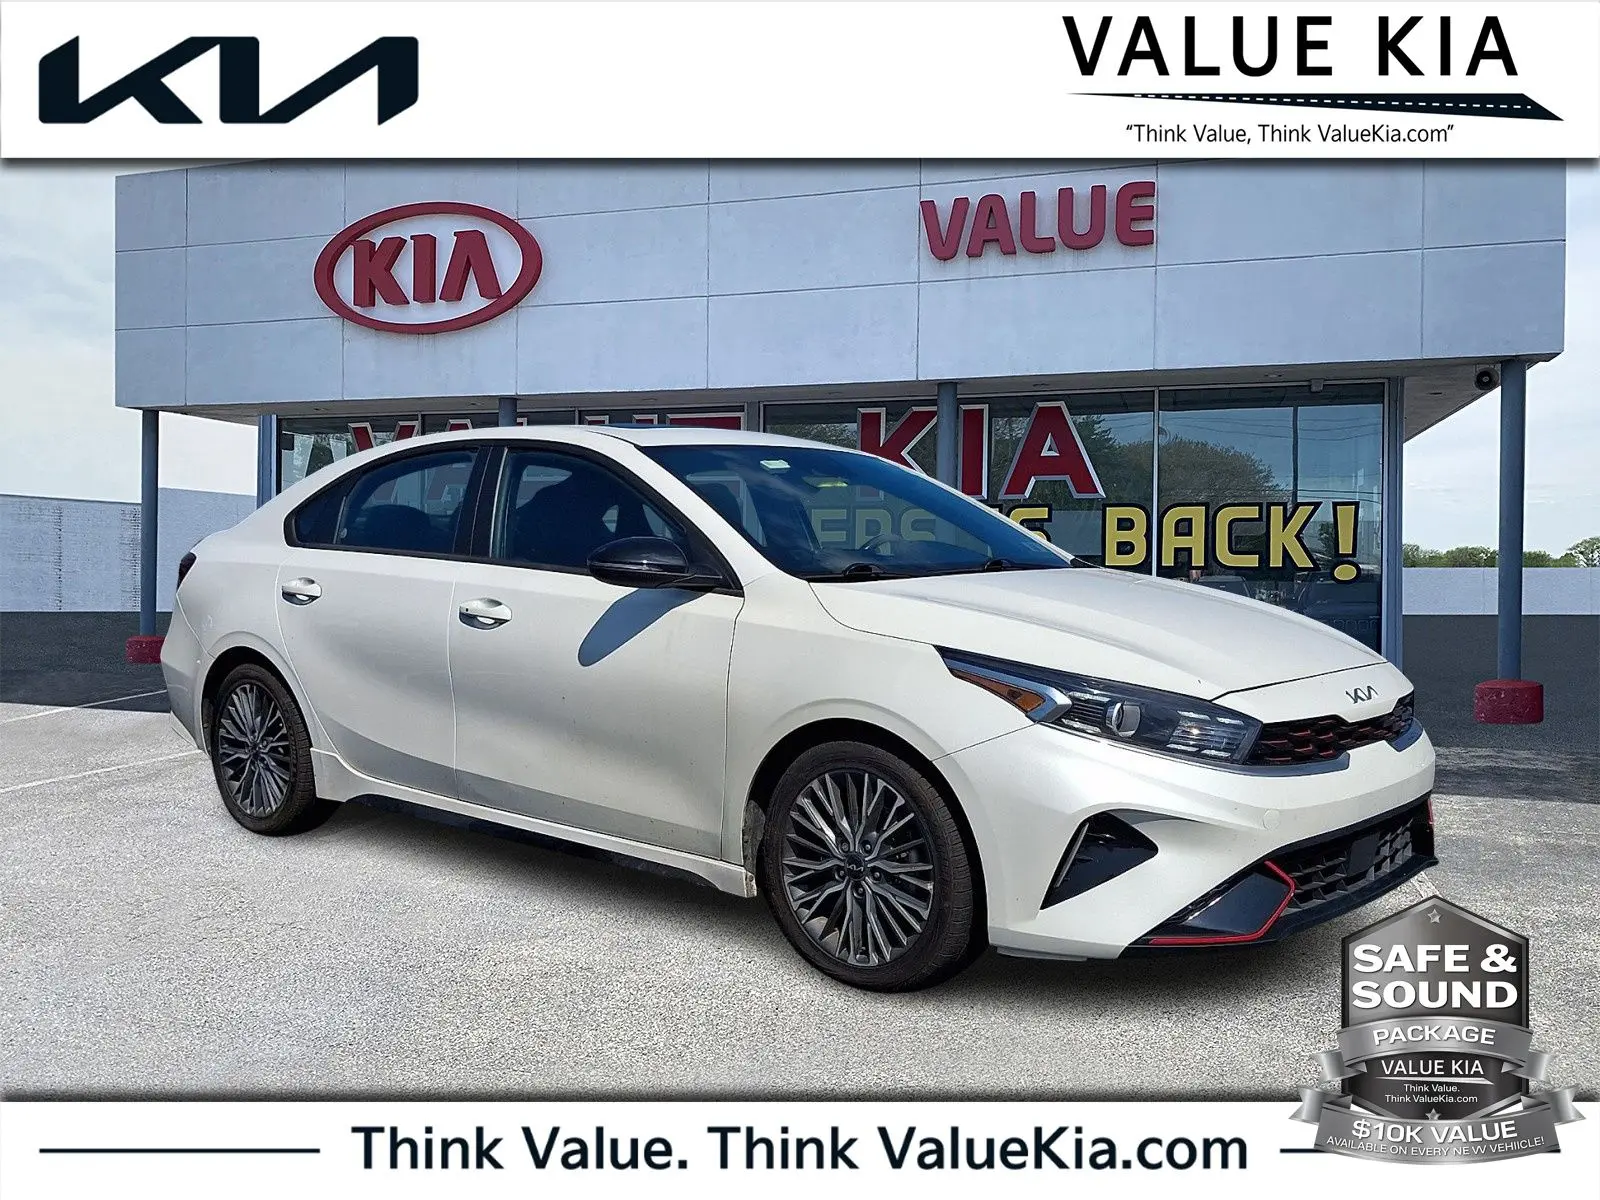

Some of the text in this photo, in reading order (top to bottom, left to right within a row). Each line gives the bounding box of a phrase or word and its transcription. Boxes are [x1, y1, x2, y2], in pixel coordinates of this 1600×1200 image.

[919, 181, 1157, 262] VALUE
[352, 229, 503, 308] KIA
[857, 401, 1106, 500] KIA
[1101, 501, 1362, 585] BACK!
